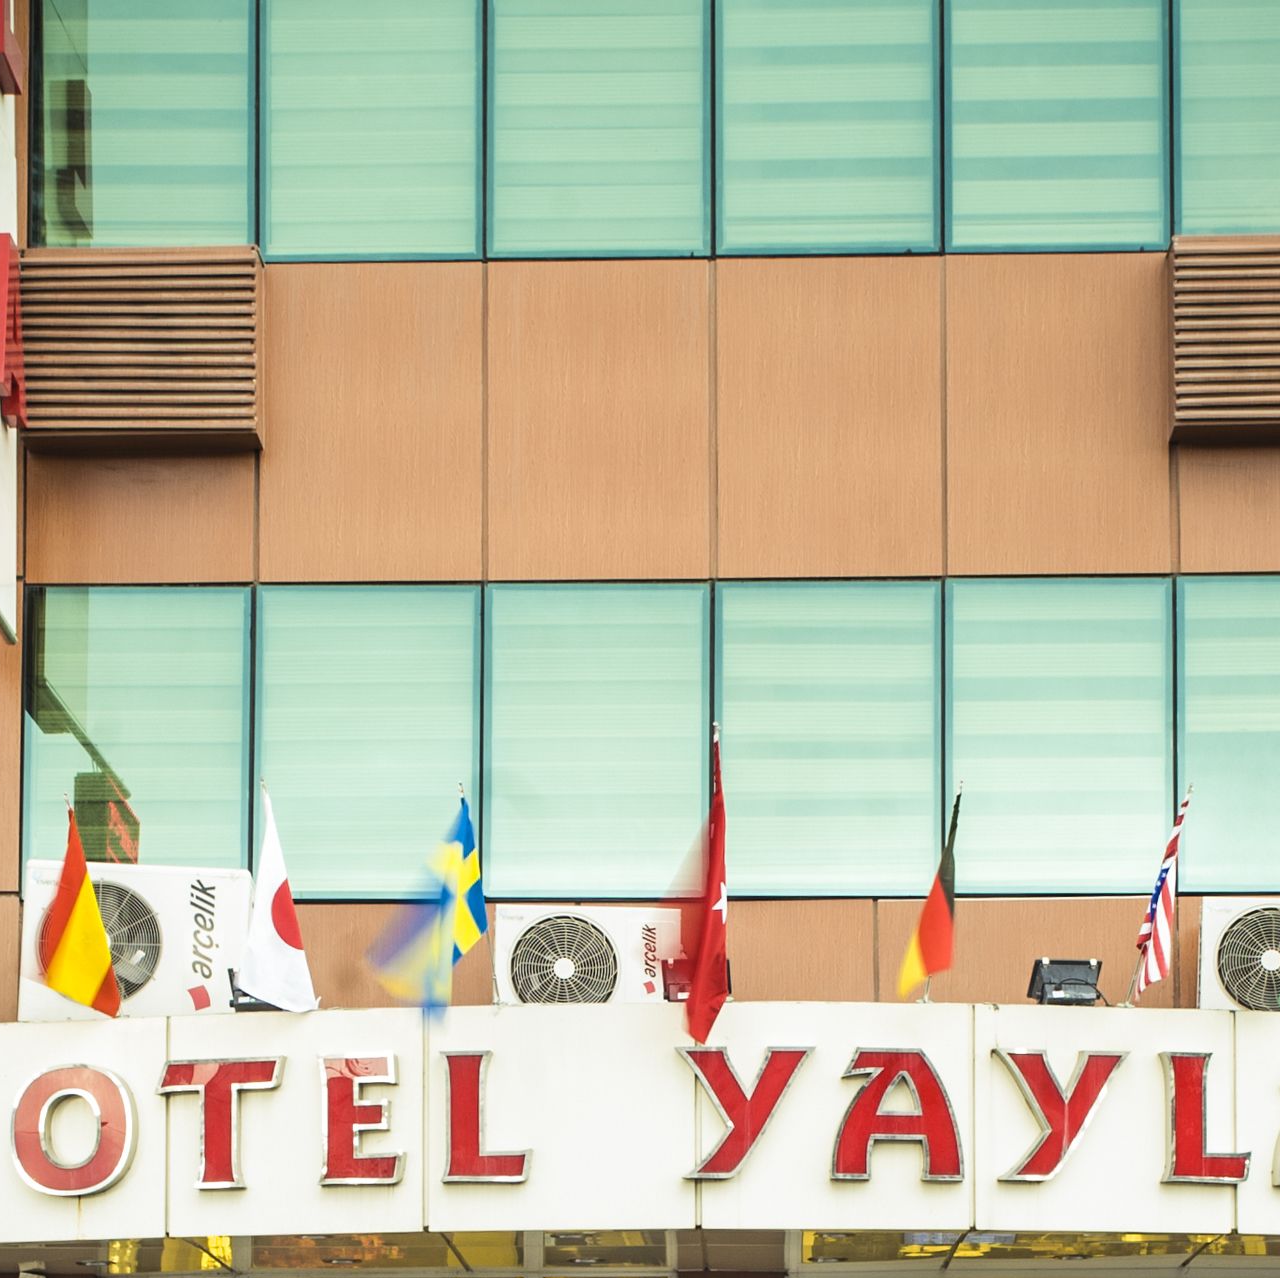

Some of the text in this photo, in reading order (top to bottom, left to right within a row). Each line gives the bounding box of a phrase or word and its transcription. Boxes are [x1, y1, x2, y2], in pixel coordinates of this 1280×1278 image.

[189, 879, 220, 979] arçelik
[641, 923, 661, 978] arçelik
[10, 1050, 534, 1197] OTEL
